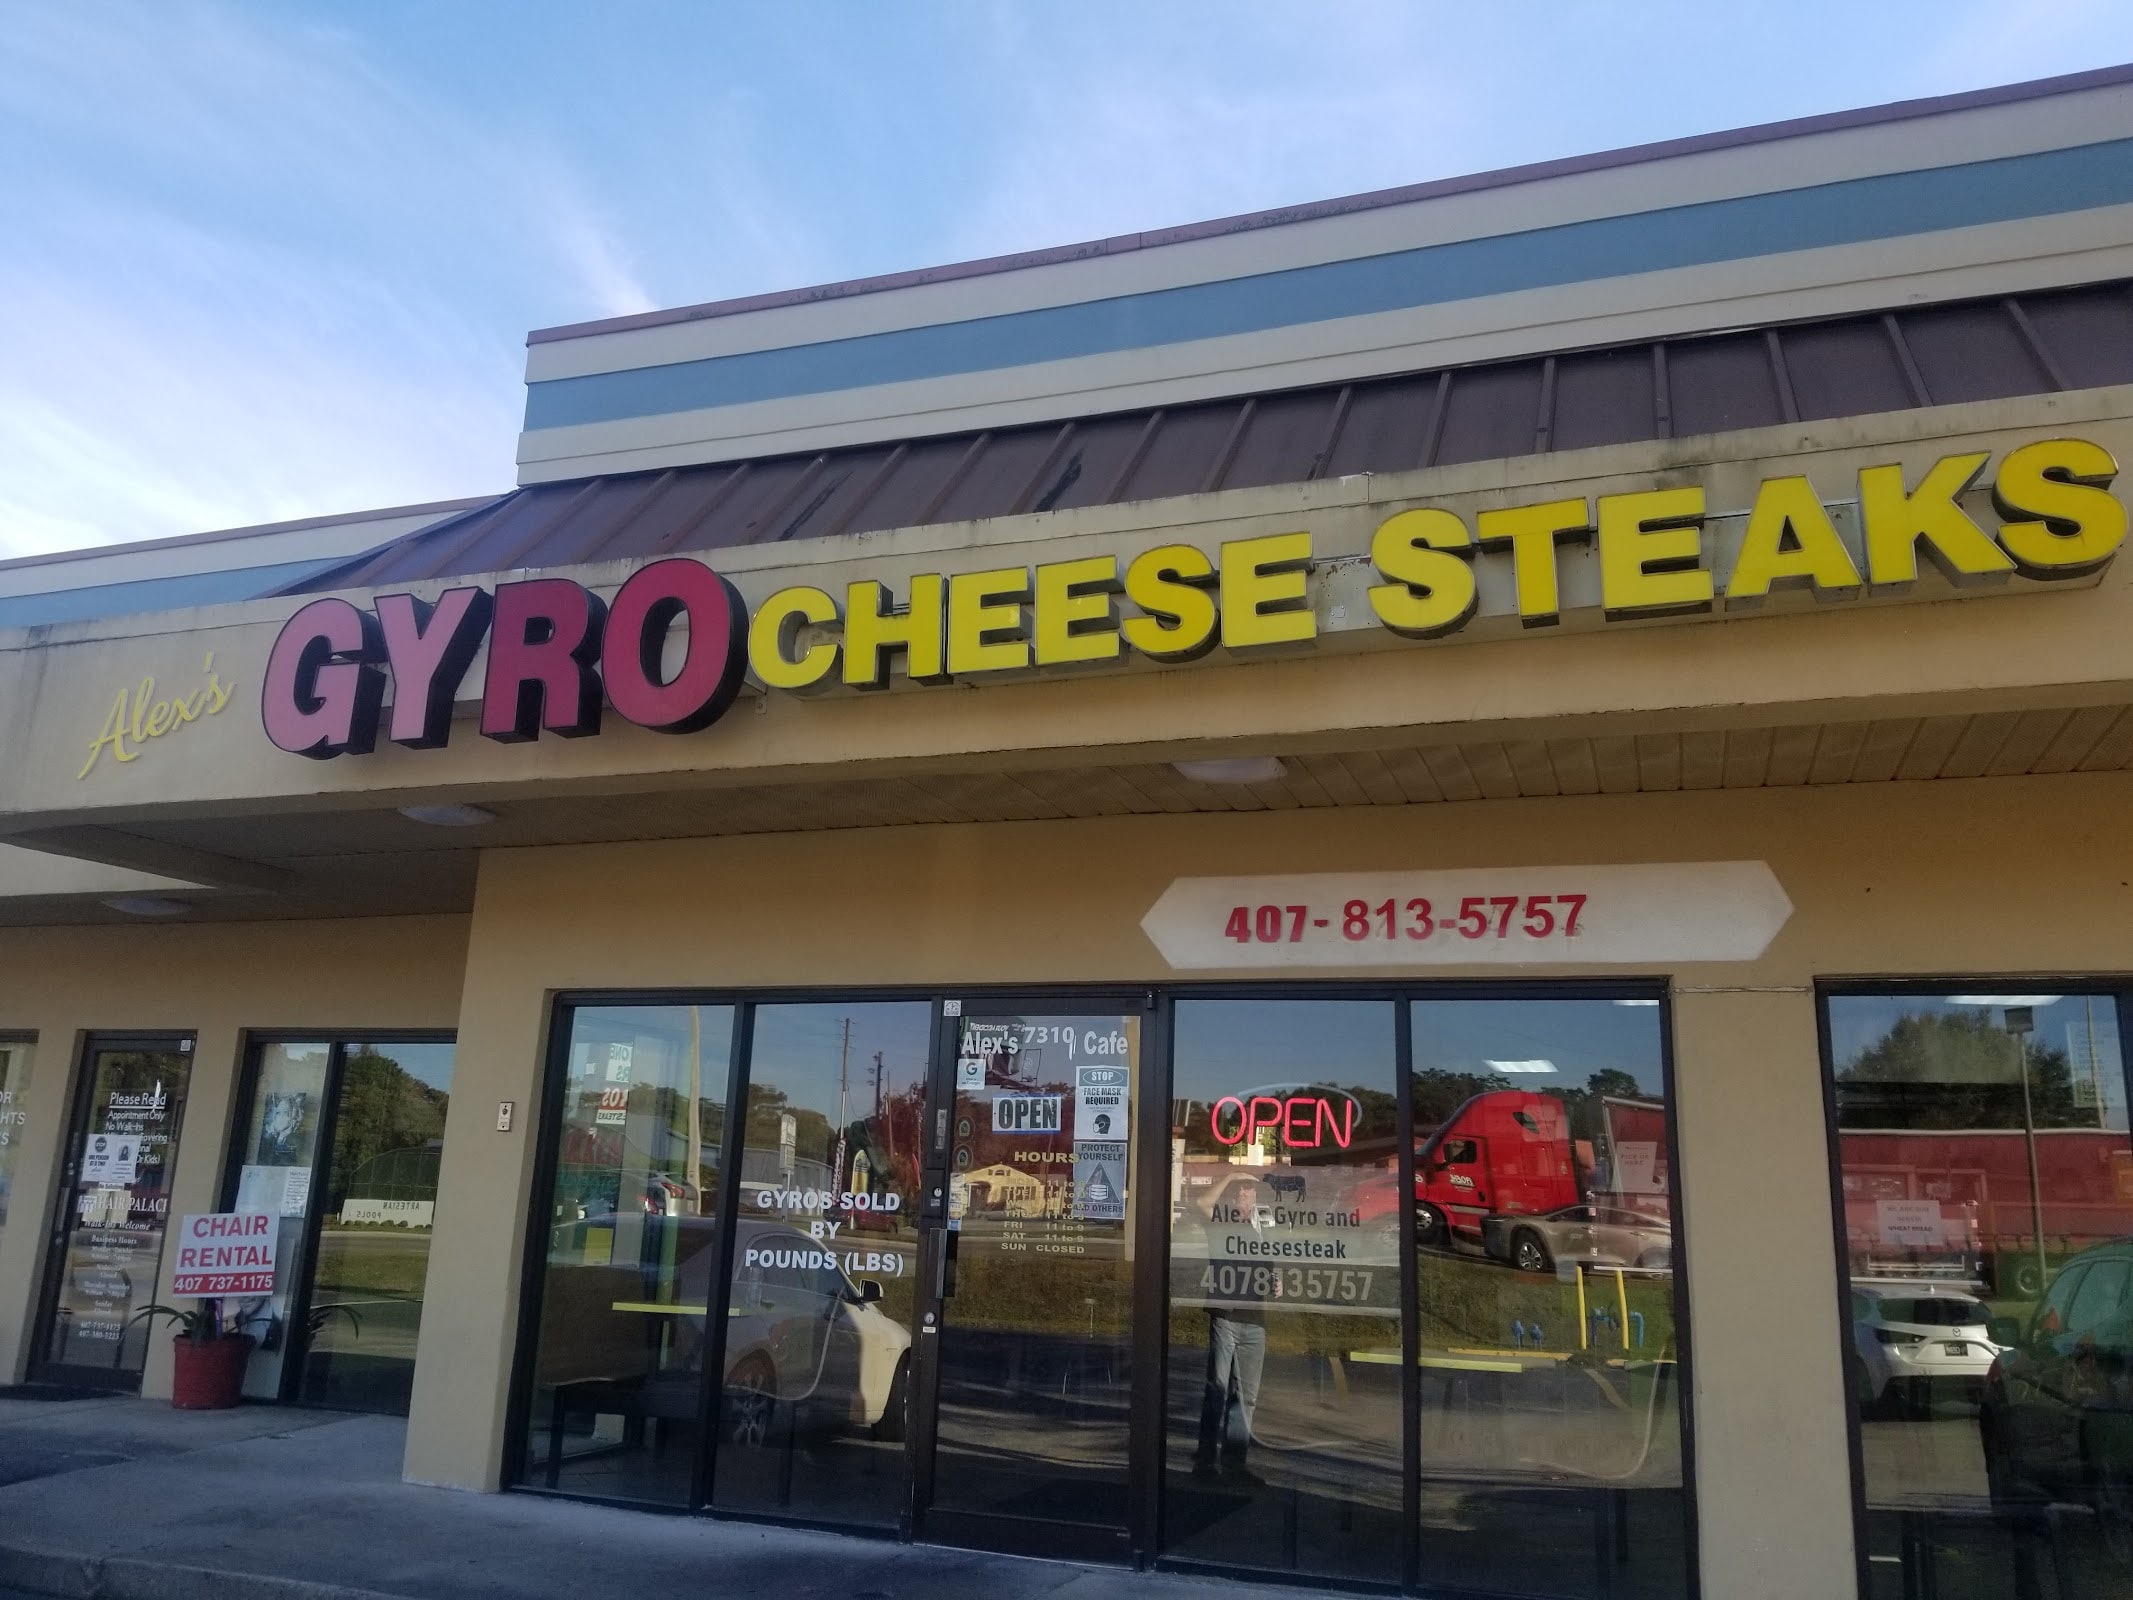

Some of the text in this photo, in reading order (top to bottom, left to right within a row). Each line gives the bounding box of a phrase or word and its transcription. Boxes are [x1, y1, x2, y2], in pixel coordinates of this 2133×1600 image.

[260, 438, 2128, 761] GYRO CHEESE STEAKS
[79, 651, 236, 780] Alex's
[961, 1030, 1129, 1055] Alex's Cafe
[1091, 1071, 1114, 1081] STOP
[109, 1091, 140, 1106] Please
[1083, 1088, 1122, 1096] FACE MASK
[1085, 1096, 1120, 1105] REQUIRED
[107, 1110, 149, 1121] Appointment
[998, 1098, 1058, 1129] OPEN
[105, 1121, 116, 1131] No
[1211, 1096, 1353, 1149] OPEN
[1081, 1143, 1121, 1152] PROTECT
[1013, 1151, 1081, 1164] HOURS
[1078, 1152, 1124, 1161] YOURSELF
[757, 1190, 900, 1211] GYROS SOLD
[1092, 1204, 1123, 1213] OTHERS
[1003, 1221, 1023, 1229] FRI
[1274, 1206, 1318, 1230] Gyro
[1326, 1208, 1361, 1228] and
[193, 1215, 269, 1238] CHAIR
[810, 1221, 842, 1240] BY
[1003, 1232, 1026, 1240] SAT
[1001, 1242, 1085, 1254] SUN CLOSED
[1226, 1235, 1347, 1259] Cheesesteak
[180, 1245, 273, 1268] RENTAL
[745, 1248, 904, 1277] POUNDS (LBS)
[174, 1274, 273, 1291] 407 737-1175
